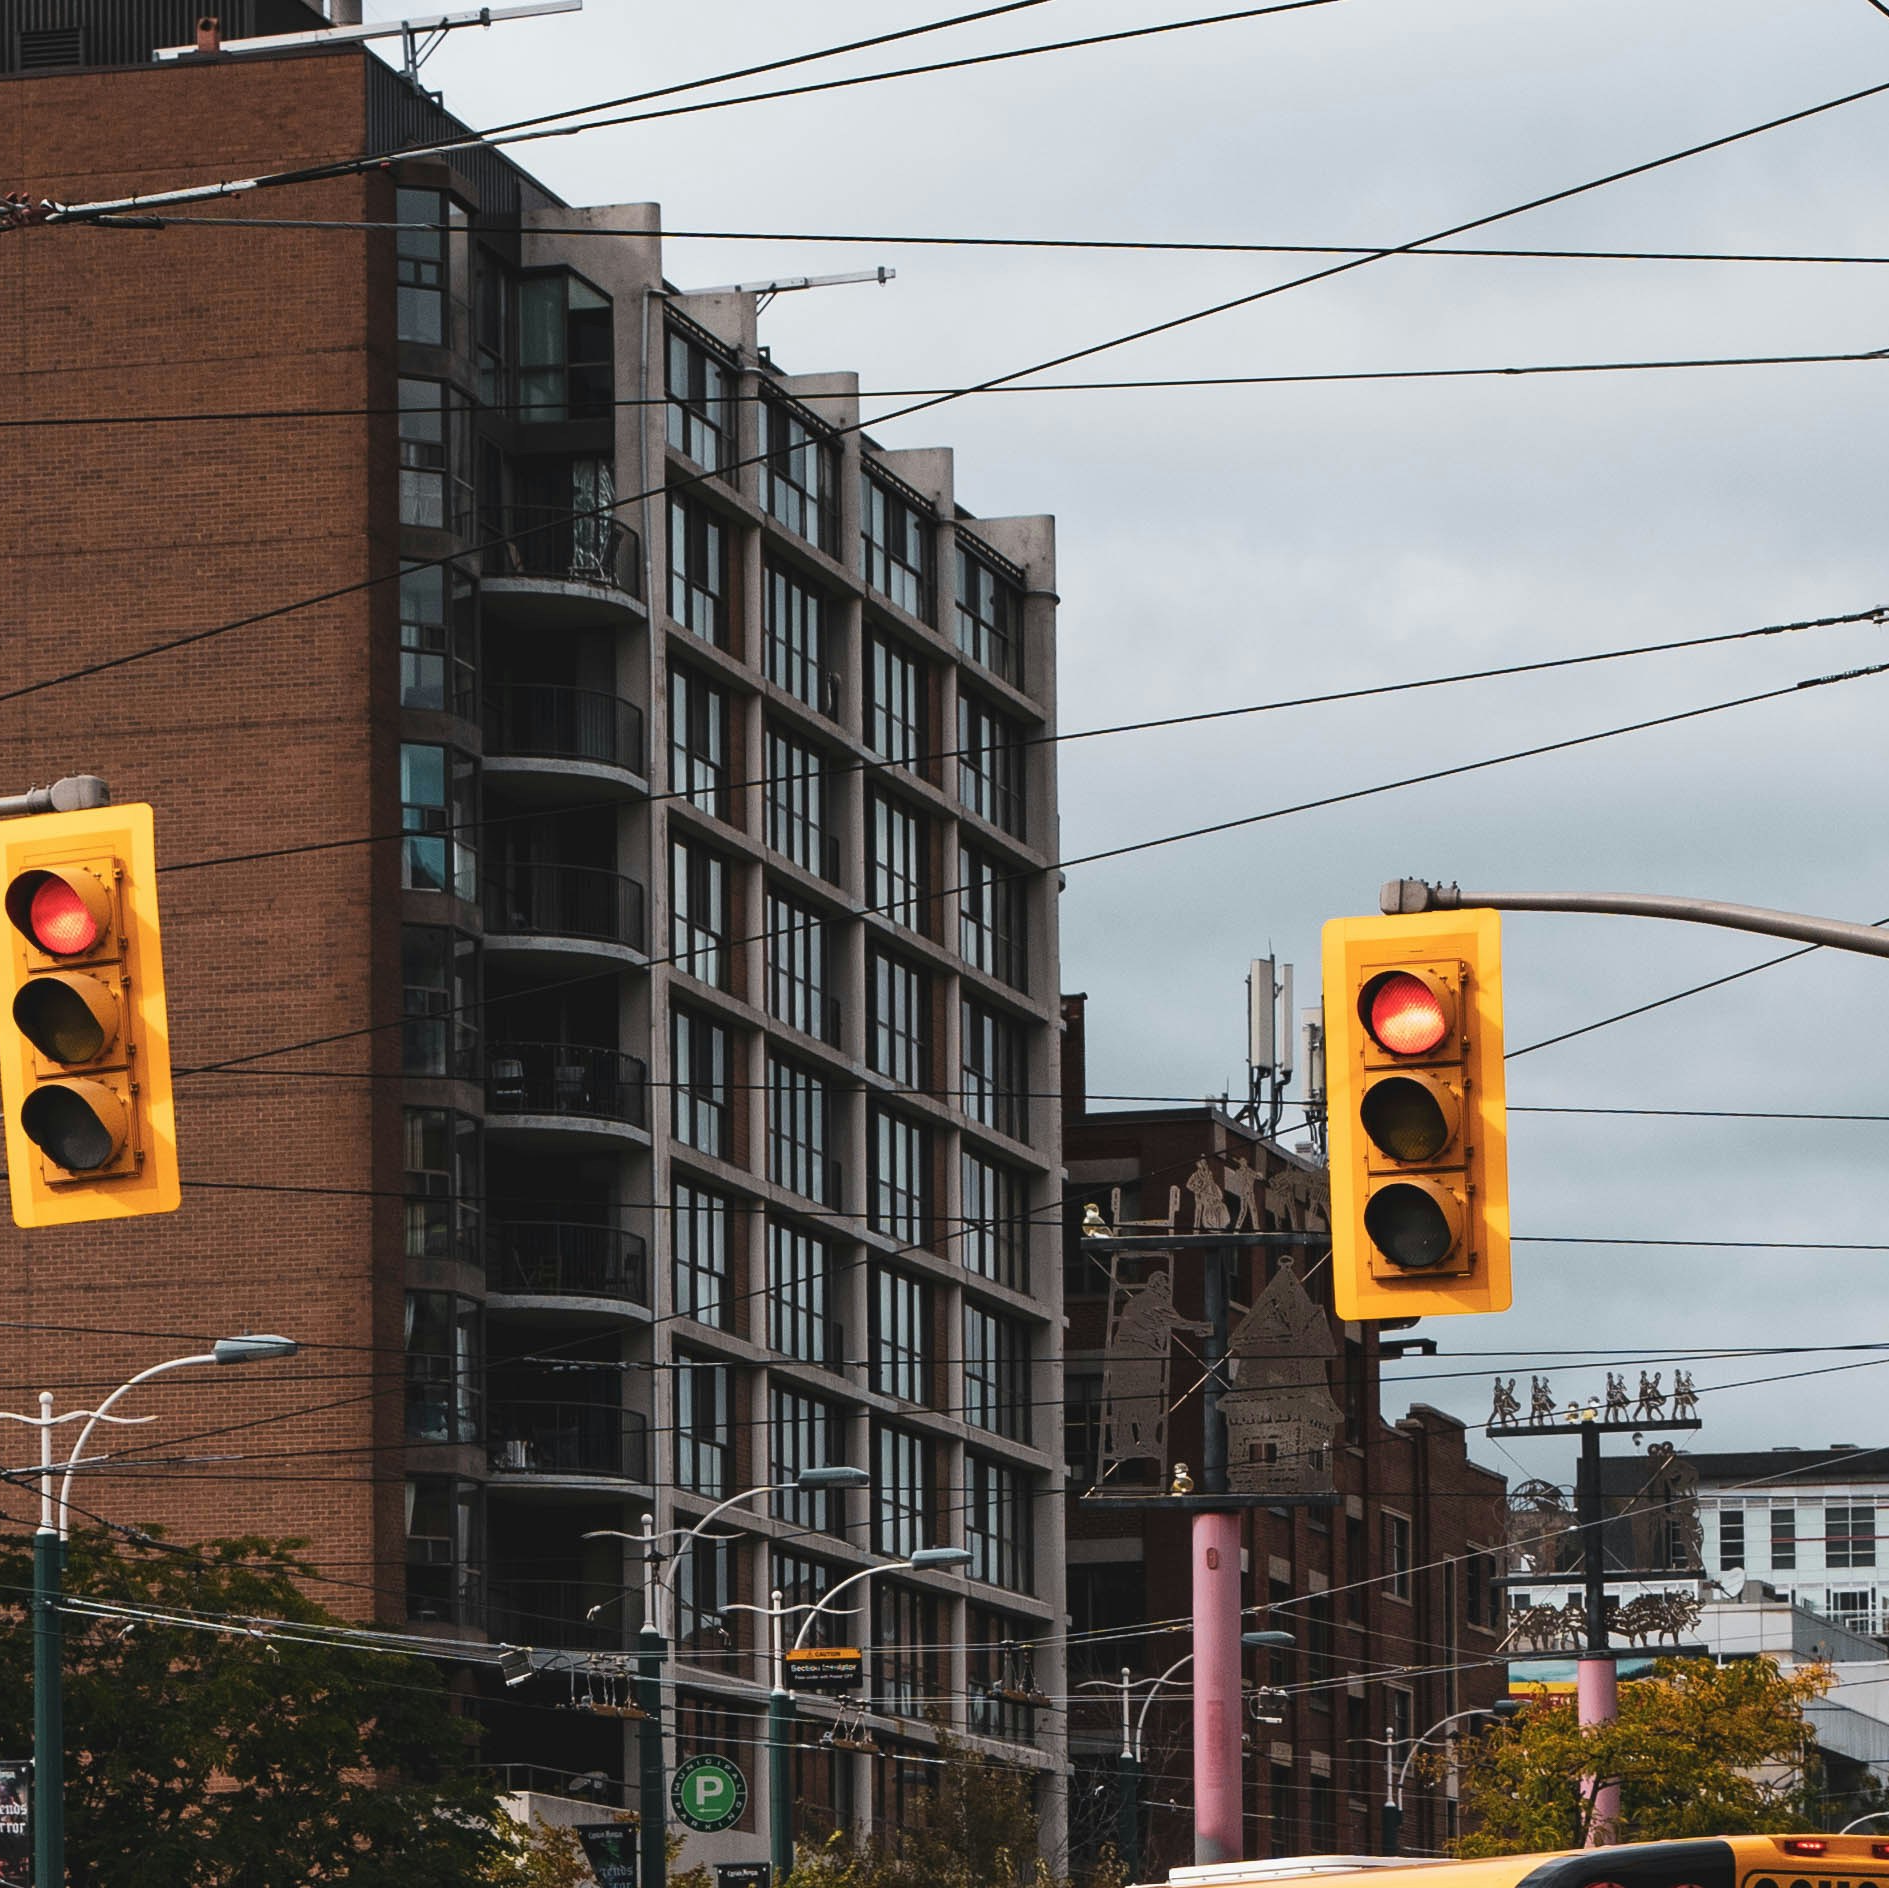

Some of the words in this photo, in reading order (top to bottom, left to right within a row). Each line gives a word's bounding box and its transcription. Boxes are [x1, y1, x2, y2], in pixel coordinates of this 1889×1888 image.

[674, 1758, 743, 1792] MUNICIPAL
[696, 1775, 724, 1805] P
[674, 1801, 743, 1830] PARKING
